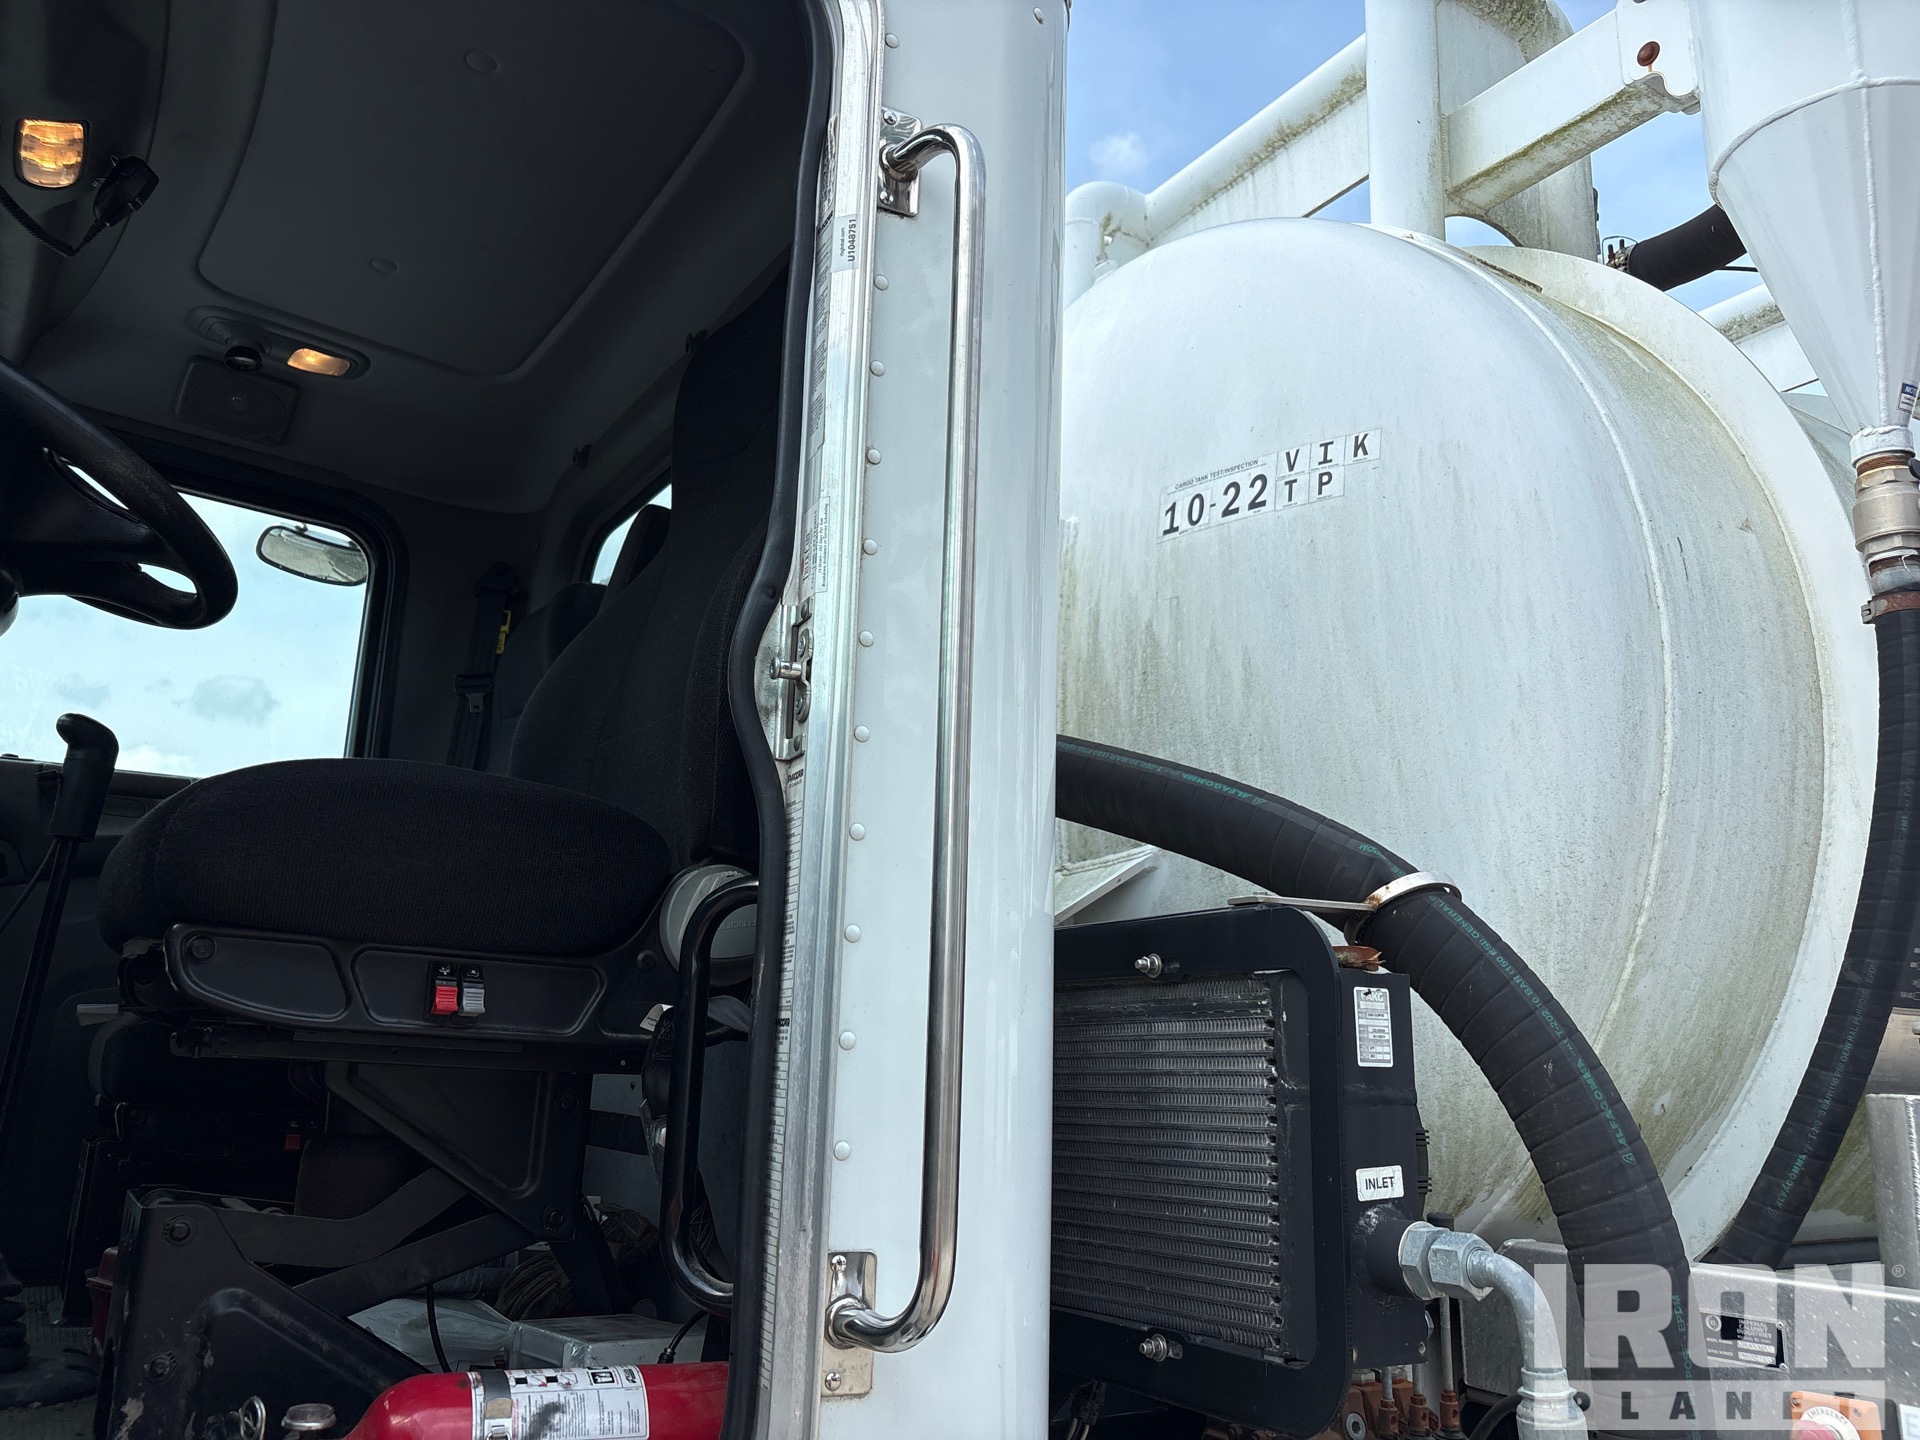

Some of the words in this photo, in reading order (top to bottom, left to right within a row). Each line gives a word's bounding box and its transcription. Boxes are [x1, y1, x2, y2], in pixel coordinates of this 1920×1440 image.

[847, 218, 856, 262] U1048751
[1174, 476, 1194, 490] CARGO
[1194, 471, 1210, 485] TANK
[1162, 473, 1268, 536] 10-22
[1437, 898, 1481, 940] GENERAL
[1512, 973, 1534, 997] BAR
[1541, 1008, 1565, 1038] T-202
[1575, 1057, 1629, 1147] ALFAGOMMA
[1364, 1176, 1395, 1190] INLET
[1671, 1294, 1686, 1332] EPDM
[1807, 1408, 1848, 1426] EMERGENCY
